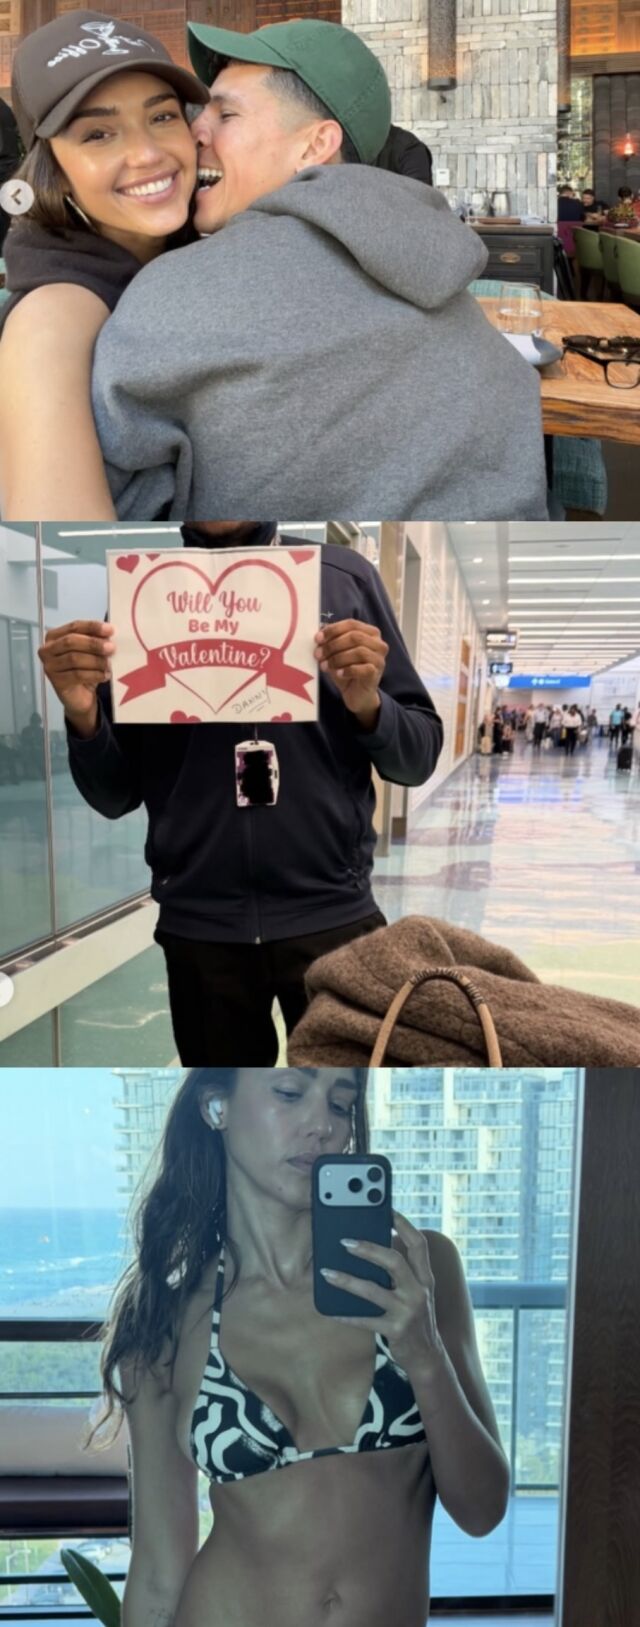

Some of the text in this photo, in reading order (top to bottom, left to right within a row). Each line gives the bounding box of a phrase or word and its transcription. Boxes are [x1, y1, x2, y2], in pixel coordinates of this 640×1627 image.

[166, 590, 262, 618] Will You
[188, 619, 239, 635] Be My
[158, 641, 271, 669] Valentine?
[231, 688, 271, 714] DANNY
